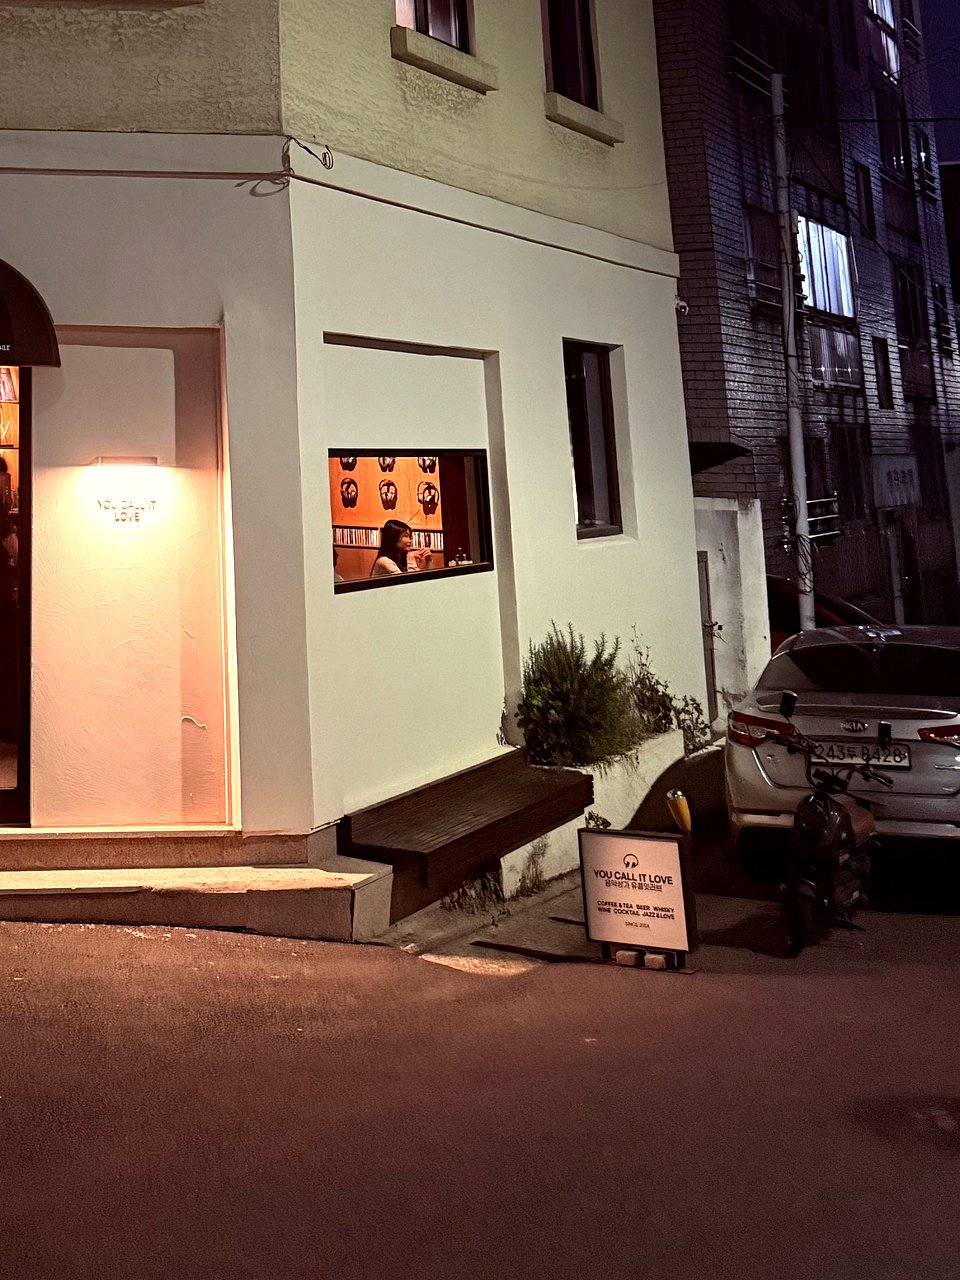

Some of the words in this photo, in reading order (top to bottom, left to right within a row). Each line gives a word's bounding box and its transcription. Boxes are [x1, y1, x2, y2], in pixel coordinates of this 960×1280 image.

[114, 512, 140, 522] LOVE
[847, 722, 864, 730] KIA
[593, 869, 613, 879] YOU
[614, 871, 638, 882] CALL
[638, 873, 647, 882] IT
[648, 874, 674, 885] LOVE
